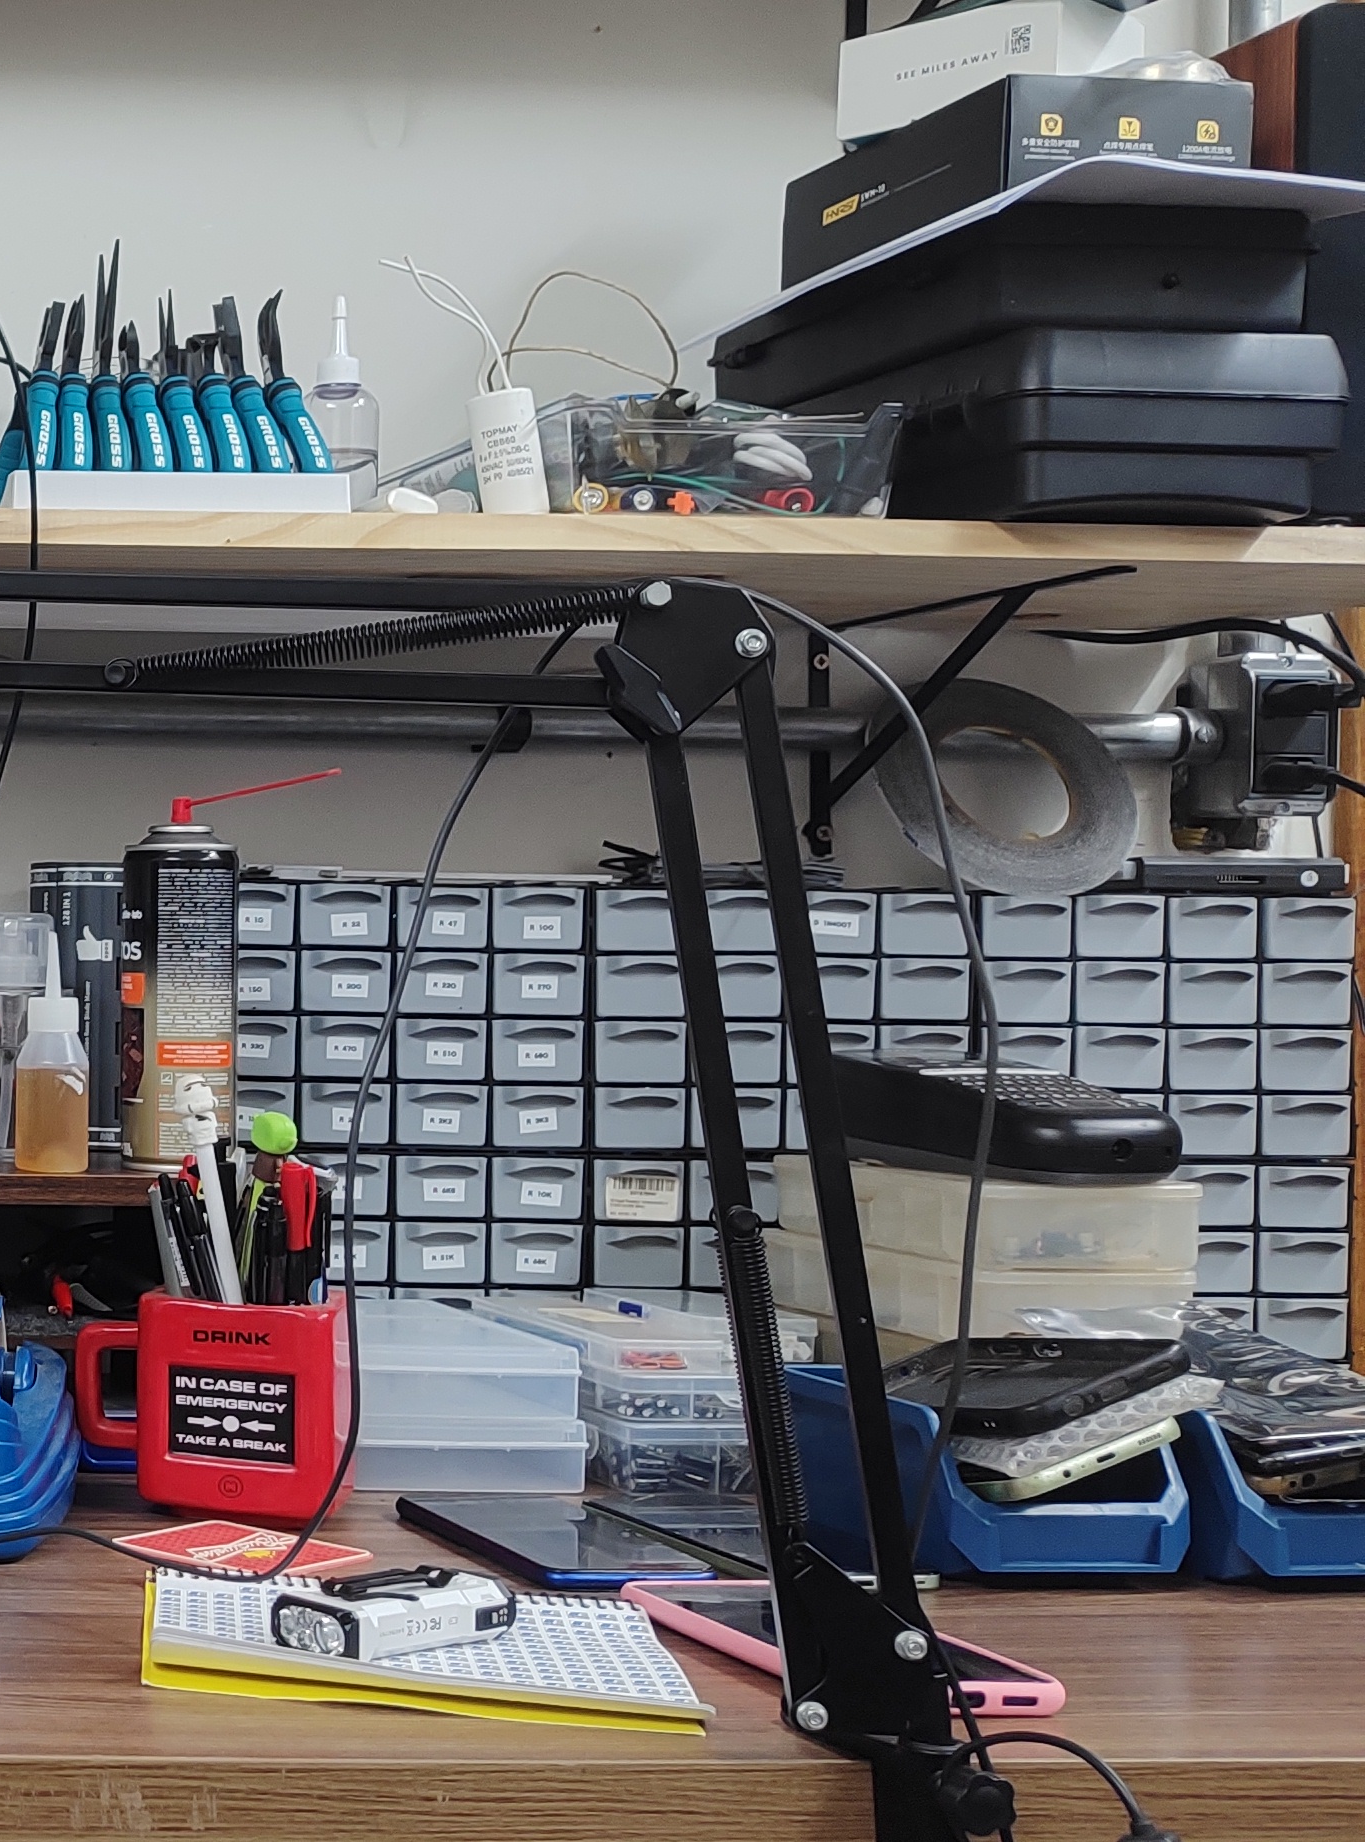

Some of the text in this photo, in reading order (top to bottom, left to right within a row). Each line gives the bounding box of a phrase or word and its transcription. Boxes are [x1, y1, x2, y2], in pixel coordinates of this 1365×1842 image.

[896, 50, 998, 81] SEE MILES AWAY
[36, 409, 52, 468] GROSS
[72, 411, 86, 467] GROSS
[107, 413, 123, 468] GROSS
[145, 412, 166, 468] GROSS
[182, 414, 205, 469] GROSS
[221, 413, 245, 469] GROSS
[256, 415, 284, 469] GROSS
[297, 416, 327, 469] GROSS
[481, 424, 518, 440] TOPMAY
[193, 1330, 271, 1345] DRINK
[175, 1376, 288, 1396] IN CASE OF
[175, 1395, 288, 1414] EMERGENCY
[175, 1433, 287, 1453] TAKE A BREAK
